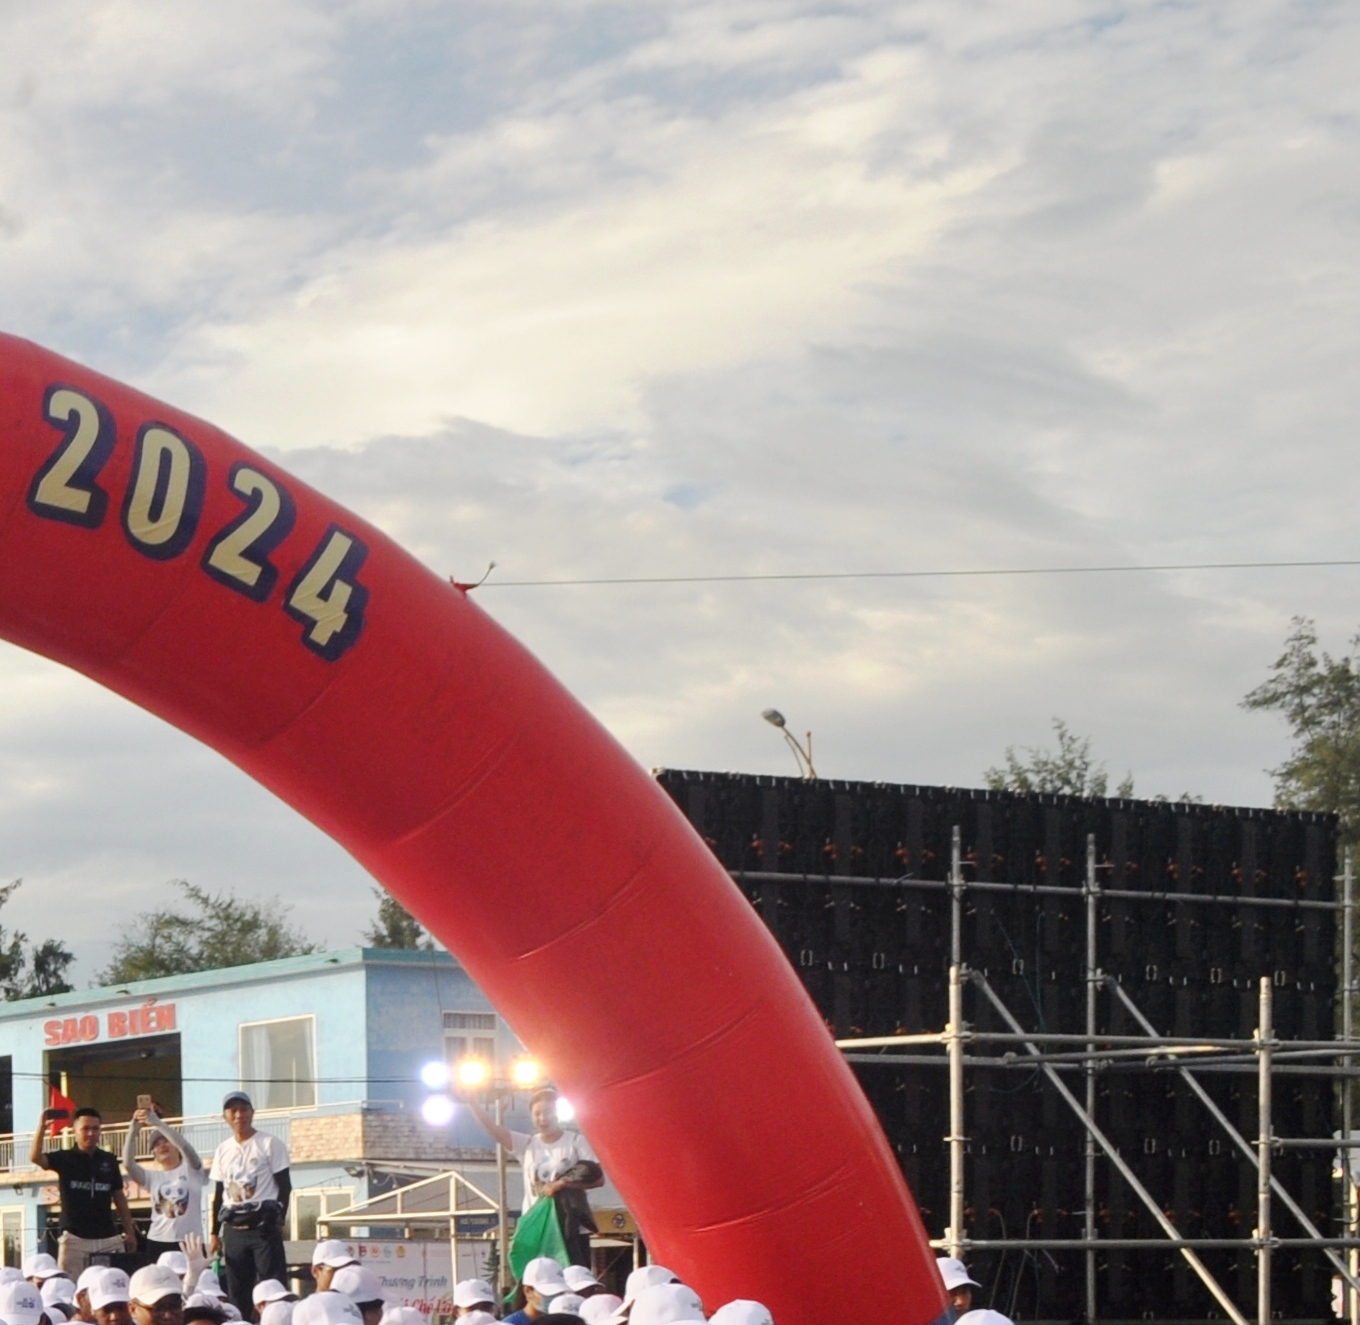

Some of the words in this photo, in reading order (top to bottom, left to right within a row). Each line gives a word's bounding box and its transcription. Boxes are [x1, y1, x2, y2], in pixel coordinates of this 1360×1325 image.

[27, 382, 369, 661] 2024
[43, 1014, 99, 1046] SAO
[107, 996, 176, 1038] BIỂN
